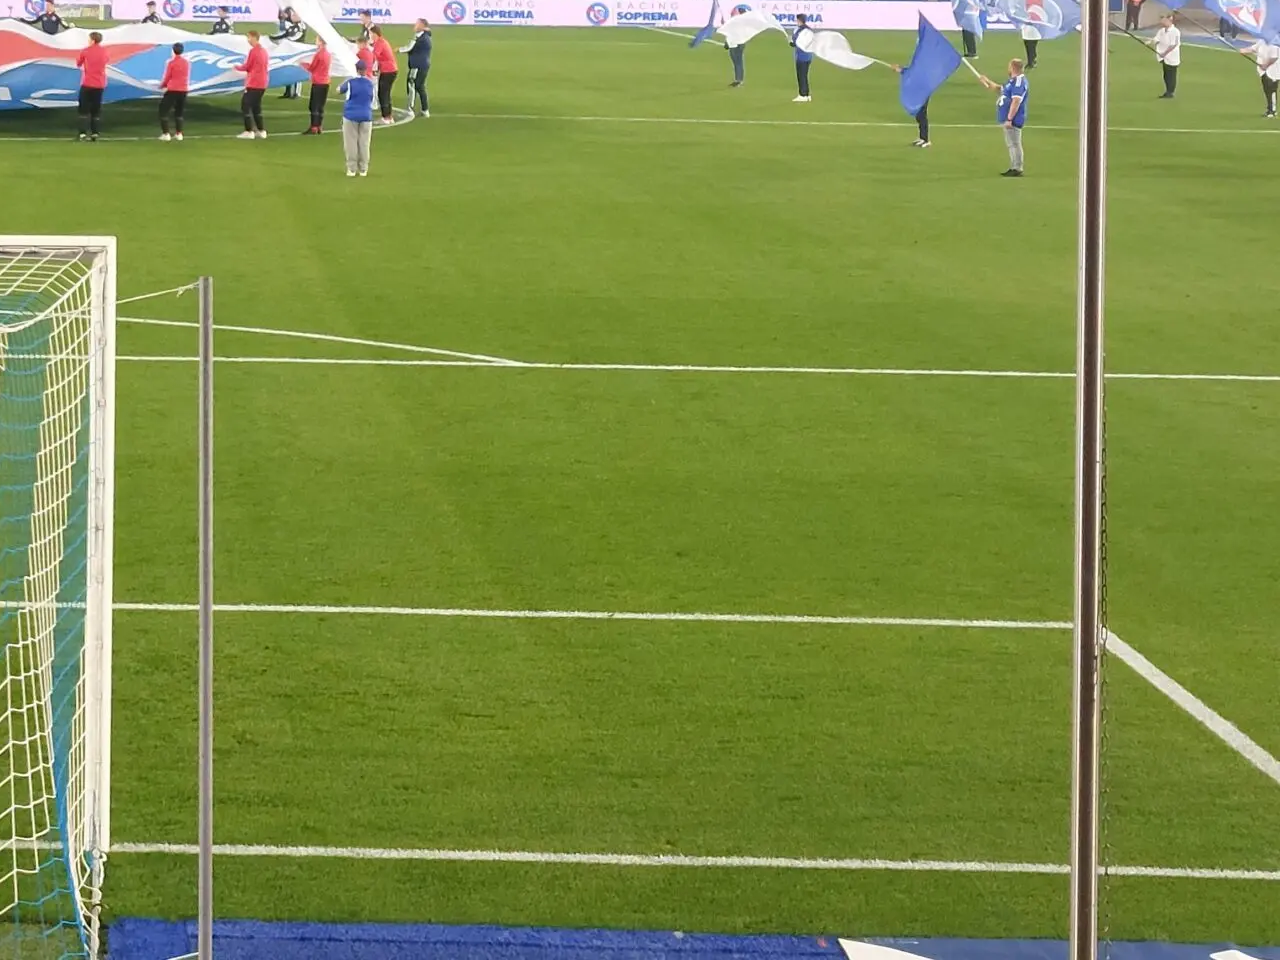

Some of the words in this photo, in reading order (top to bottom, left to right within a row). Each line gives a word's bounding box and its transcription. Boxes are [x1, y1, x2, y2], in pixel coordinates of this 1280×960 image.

[473, 0, 536, 8] RACING
[616, 2, 679, 10] RACING
[192, 5, 252, 14] SOPEMA
[473, 9, 535, 19] SOPREMA
[616, 11, 678, 21] SOPREMA
